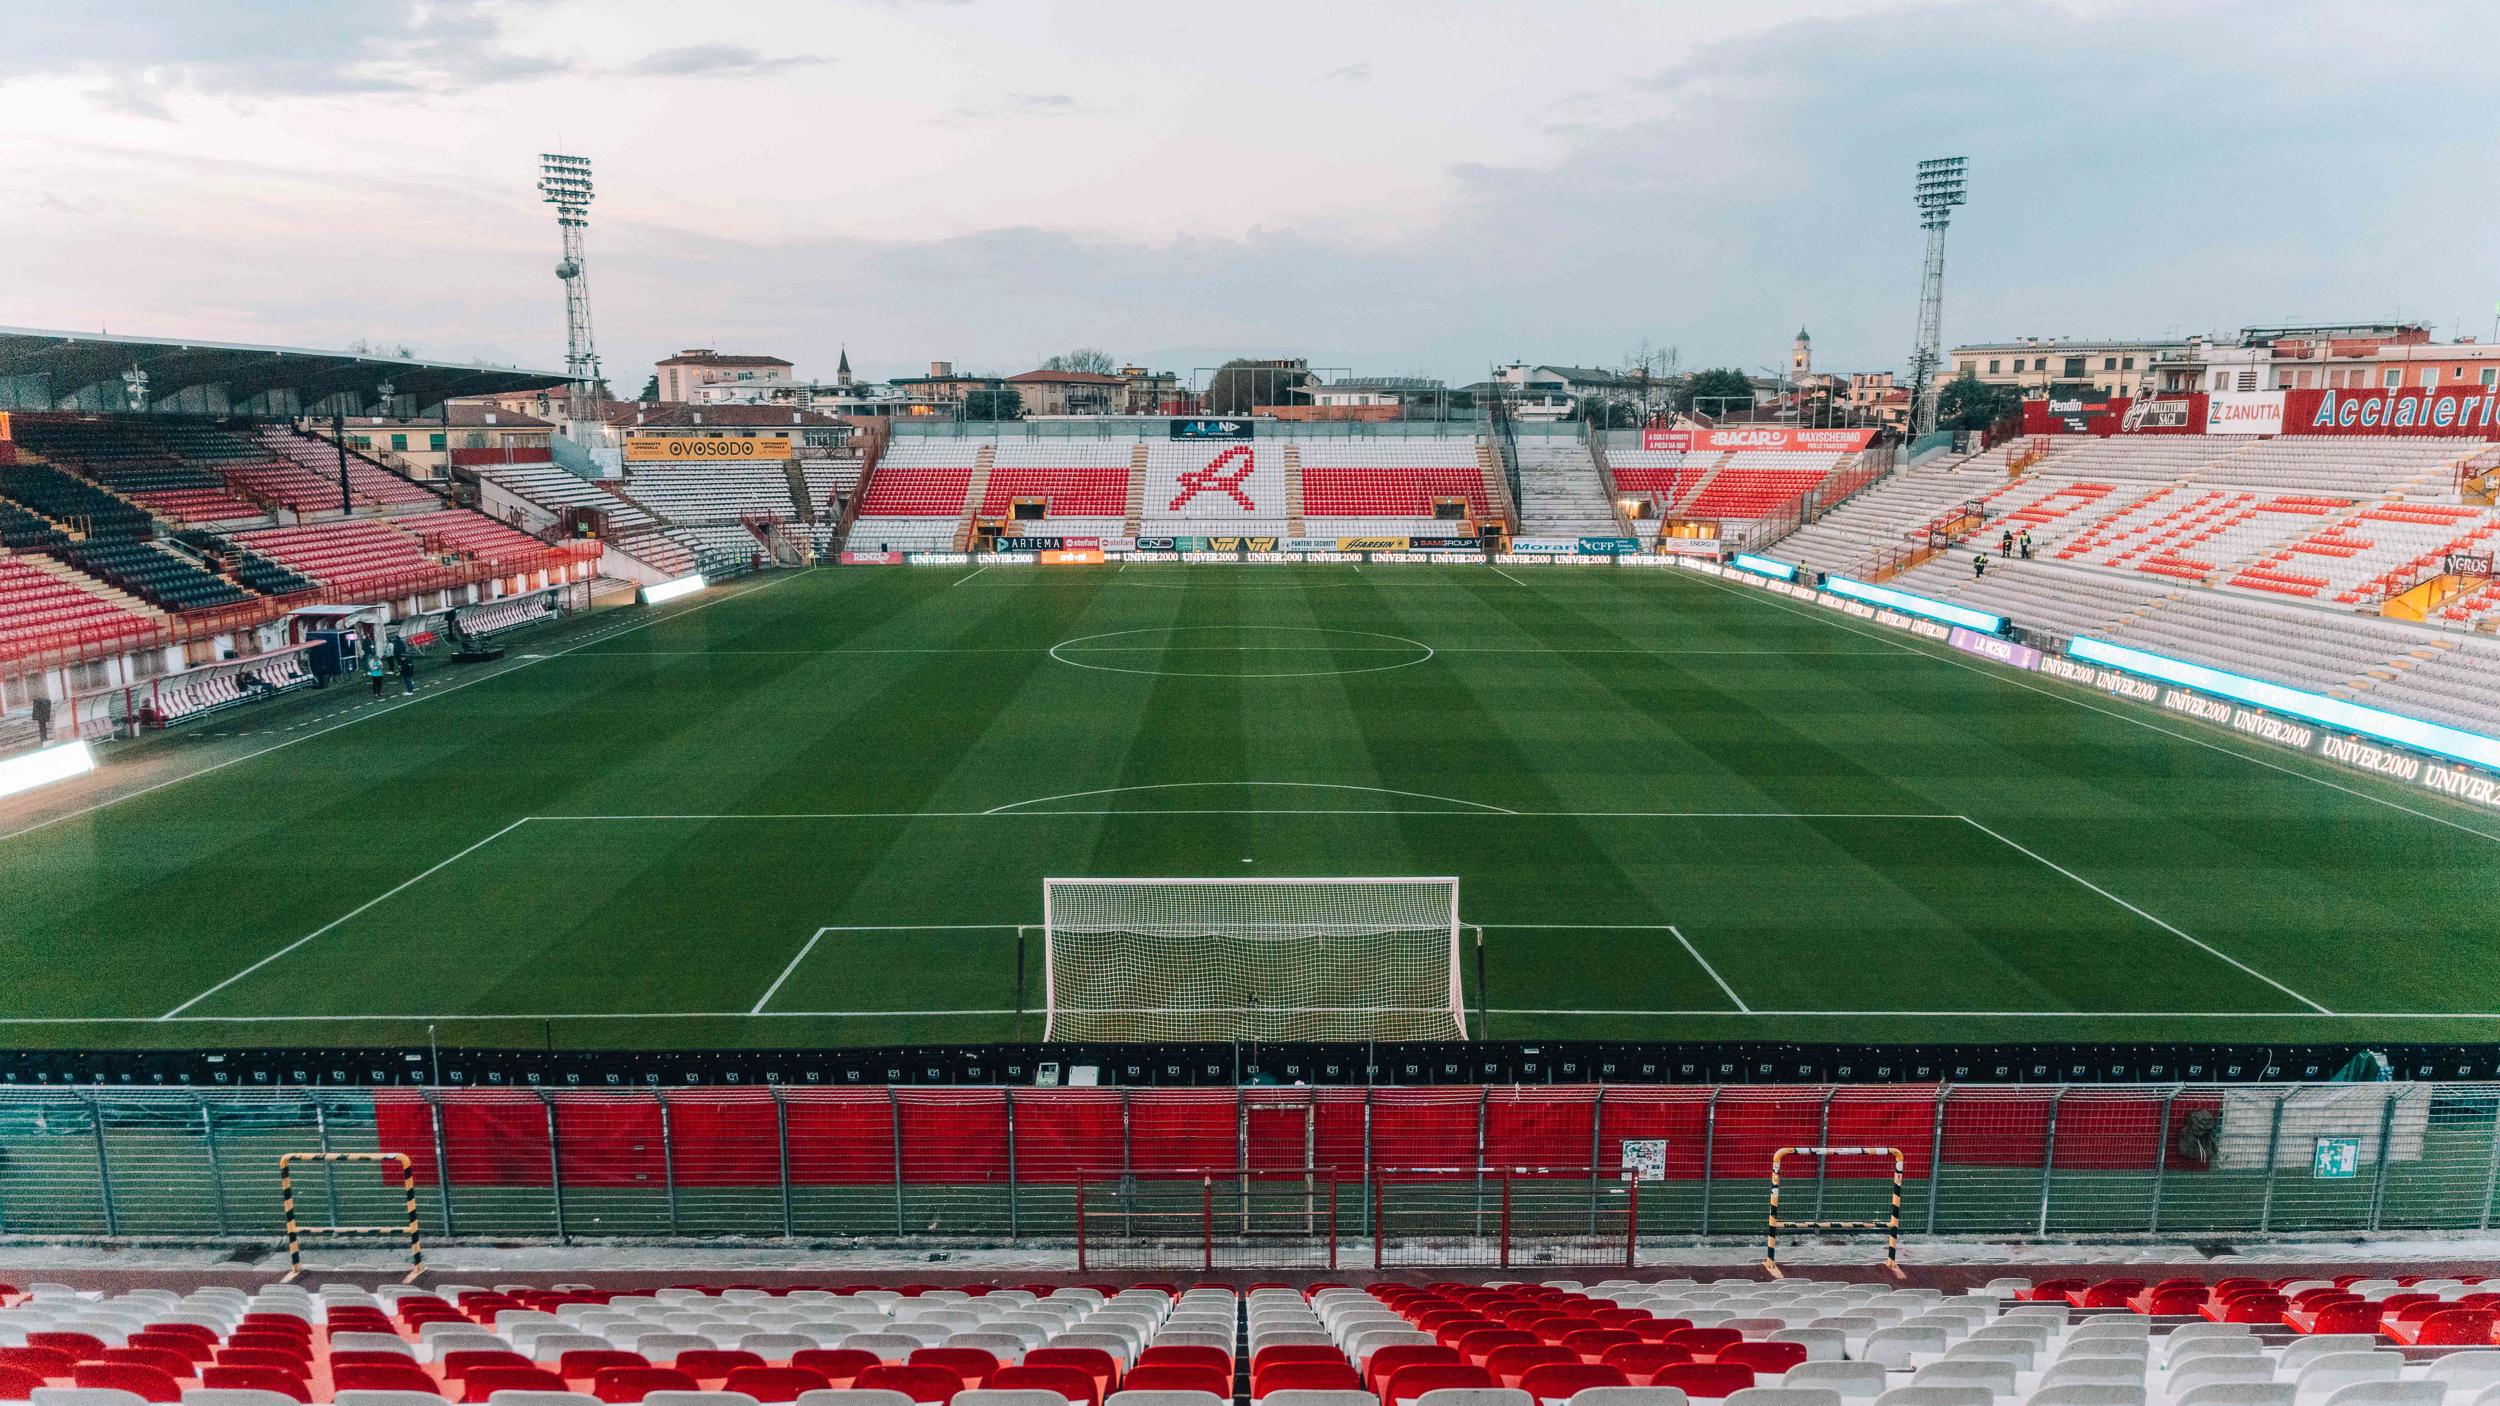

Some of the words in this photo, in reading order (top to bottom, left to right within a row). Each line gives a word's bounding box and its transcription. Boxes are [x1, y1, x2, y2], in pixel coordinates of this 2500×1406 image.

[2048, 399, 2082, 412] Pendin
[2225, 404, 2281, 420] ZANUTTA
[2158, 413, 2176, 425] SAGI
[1797, 432, 1860, 442] MAXISCHERMO
[669, 441, 753, 456] OVOSODO
[1012, 538, 1060, 548] ARTEMA
[1073, 539, 1098, 547] stefani
[1109, 538, 1134, 547] stefani
[1513, 542, 1578, 551] Morari
[1592, 541, 1614, 551] CFP
[911, 554, 967, 564] UNIVER2000
[977, 554, 1033, 563] UNIVER2000
[1123, 552, 1178, 562] UNIVER2000
[1307, 552, 1362, 562] UNIVER2000
[1371, 553, 1426, 563] UNIVER2000
[1431, 553, 1486, 563] UNIVER2000
[1495, 554, 1550, 564] UNIVER2000
[1554, 555, 1611, 564] UNIVER2000
[1985, 640, 2012, 660] VICENZA
[2041, 656, 2095, 684] UNIVER2000
[2096, 671, 2158, 701] UNIVER2000
[2165, 689, 2232, 723] UNIVER2000
[2233, 709, 2311, 749] UNIVER2000
[2322, 736, 2420, 781] UNIVER2000
